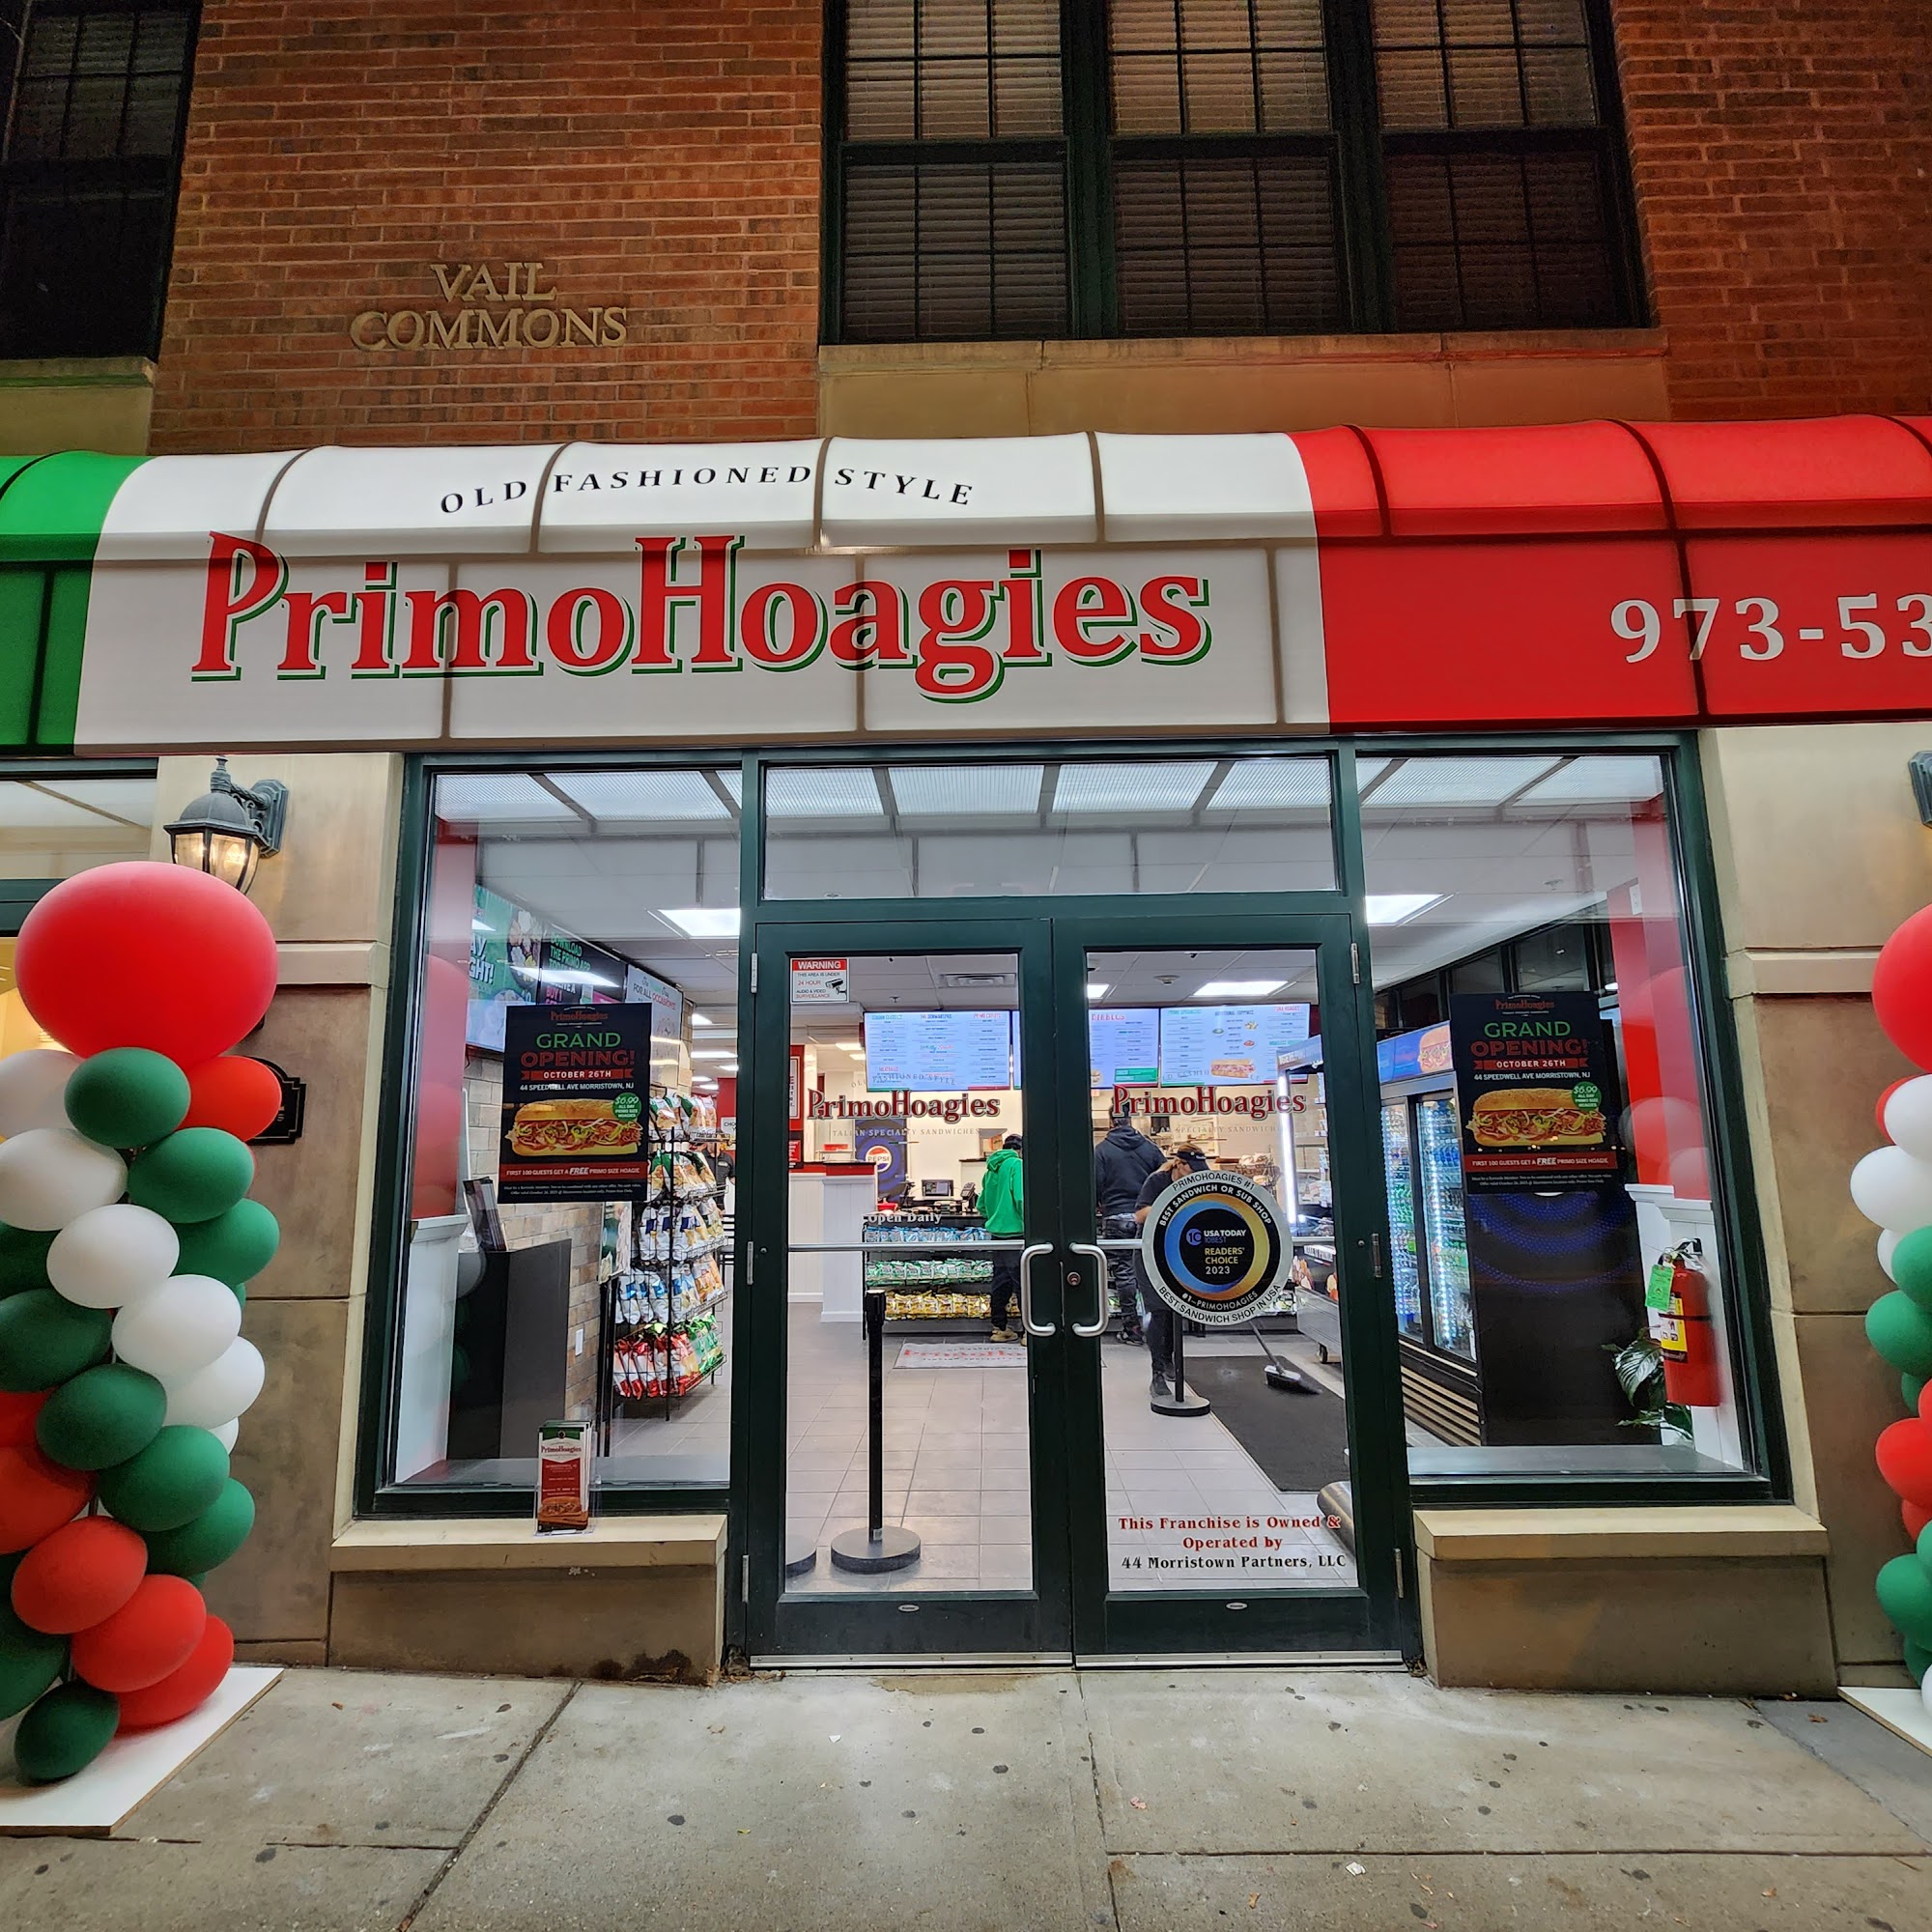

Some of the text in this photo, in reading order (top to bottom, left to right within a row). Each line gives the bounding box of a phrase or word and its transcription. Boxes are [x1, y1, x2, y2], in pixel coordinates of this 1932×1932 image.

[430, 262, 557, 302] VAIL
[350, 306, 627, 352] COMMONS
[440, 466, 973, 513] OLD FASHIONED STYLE
[190, 529, 1213, 704] PrimoHoagies
[1609, 592, 1932, 664] 973-53
[550, 945, 562, 961] THE
[797, 961, 841, 970] WARNING
[1484, 1021, 1571, 1038] GRAND
[536, 1032, 622, 1049] GRAND
[1470, 1038, 1589, 1058] OPENING!
[521, 1049, 636, 1068] OPENING!
[1496, 1059, 1566, 1068] OCTOBER 26TH
[543, 1070, 611, 1079] OCTOBER 26TH
[528, 1083, 566, 1092] SPEEDWELL
[580, 1082, 625, 1091] MORRISTOWN,
[807, 1088, 1001, 1123] PrimoHoagies
[1112, 1083, 1306, 1122] PrimoHoagies
[1536, 1157, 1557, 1166] FREE
[569, 1167, 589, 1176] FREE
[1172, 1172, 1256, 1192] PRIMOHOAGIES #1
[1159, 1184, 1272, 1227] BEST SANDWICH OR SUB SHOP
[868, 1211, 943, 1226] Open Daily
[1205, 1256, 1238, 1264] CHOICE
[1205, 1265, 1231, 1275] 2023
[1158, 1284, 1282, 1323] BEST SANDWICH SHOP IN USA
[1119, 1516, 1341, 1529] This Franchise is Owned &
[1182, 1536, 1283, 1551] Operated by
[1122, 1554, 1347, 1569] 44 Morristown Partners, LLC
